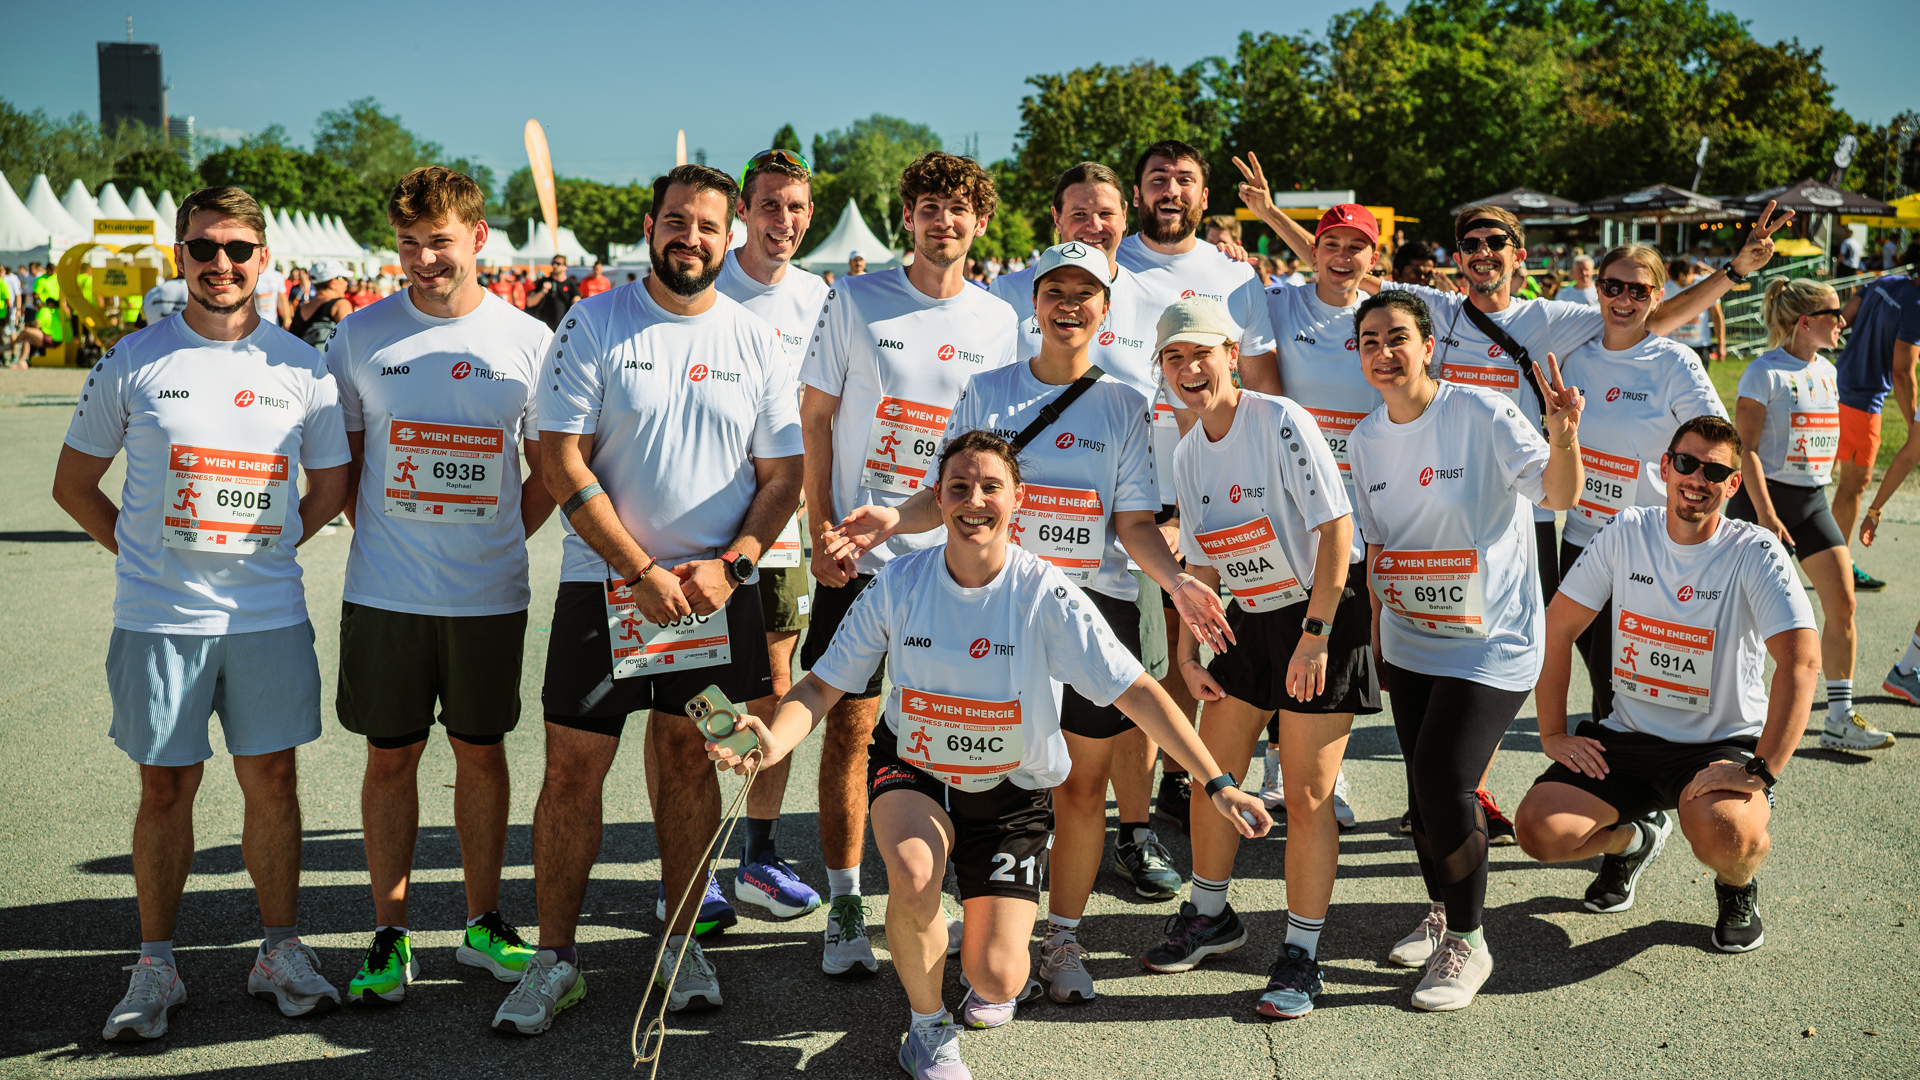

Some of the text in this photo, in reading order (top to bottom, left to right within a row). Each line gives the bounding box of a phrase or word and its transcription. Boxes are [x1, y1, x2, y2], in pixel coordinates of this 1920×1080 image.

[1030, 326, 1042, 334] JA
[782, 334, 802, 346] TRUST
[878, 338, 904, 350] JAKO
[1118, 336, 1144, 349] TRUST
[1294, 335, 1316, 345] JAKO
[958, 350, 984, 364] TRUST
[381, 366, 410, 376] JAKO
[624, 360, 652, 370] JAKO
[474, 368, 506, 382] TRUST
[710, 370, 741, 382] TRUST
[1456, 371, 1514, 382] WIEN ENERGIE
[158, 390, 190, 398] JAKO
[1622, 392, 1648, 402] TRUST
[258, 396, 290, 410] TRUST
[906, 409, 933, 422] WIEN
[880, 420, 912, 431] BUSINESS
[420, 432, 498, 446] WIEN ENERGIE
[1078, 438, 1106, 453] TRUST
[395, 446, 430, 454] BUSINESS
[914, 439, 936, 456] 69
[204, 456, 283, 473] WIEN ENERGIE
[1580, 454, 1634, 473] WIEN ENERGIE
[176, 472, 213, 482] BUSINESS
[433, 462, 486, 481] 693B
[1435, 468, 1464, 480] TRUST
[1242, 487, 1265, 498] TRUST
[1369, 482, 1386, 493] JAKO
[1586, 478, 1622, 498] 691B
[217, 489, 271, 510] 690B
[1028, 494, 1100, 508] WIEN ENERGIE
[1039, 524, 1090, 544] 694B
[1202, 526, 1268, 550] WIEN ENERGIE
[1226, 556, 1274, 578] 694A
[1397, 558, 1472, 568] WIEN ENERGIE
[1629, 572, 1654, 585] JAKO
[1414, 586, 1464, 602] 691C
[1696, 590, 1722, 600] TRUST
[1622, 632, 1648, 644] BUSINESS
[1641, 623, 1708, 644] WIEN ENERGIE
[904, 636, 932, 648] JAKO
[1650, 652, 1696, 674] 691A
[1662, 670, 1682, 678] Roman
[932, 703, 1014, 718] WIEN ENERGIE
[908, 714, 942, 727] BUSINESS
[947, 734, 1004, 753] 694C
[989, 852, 1036, 886] 21
[744, 872, 780, 898] BROOKS
